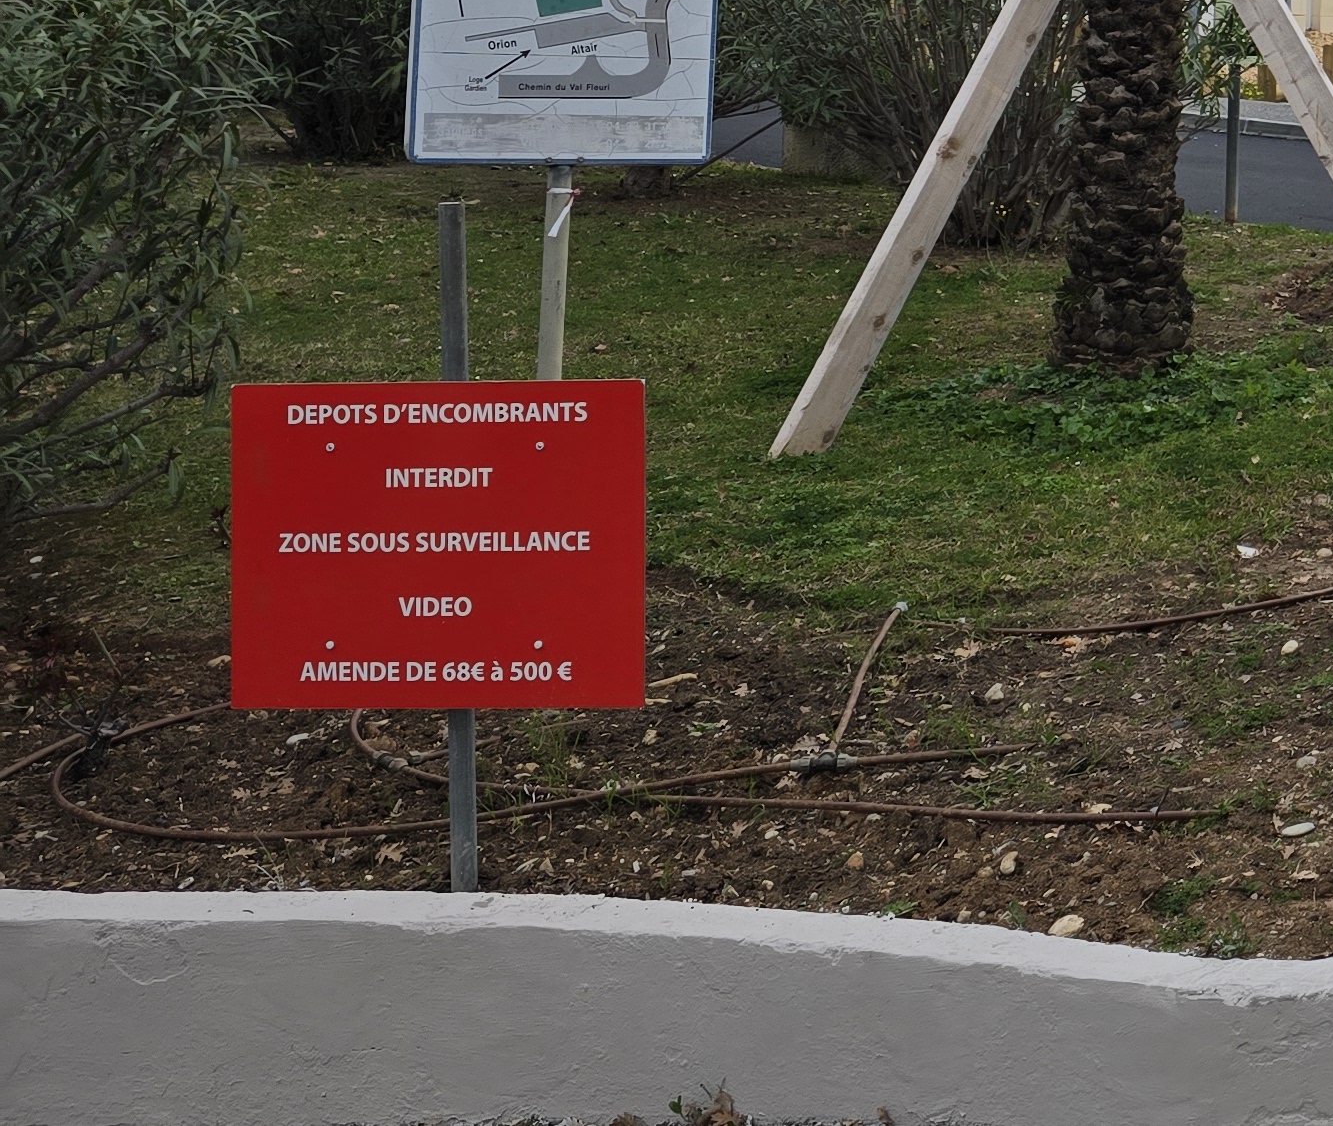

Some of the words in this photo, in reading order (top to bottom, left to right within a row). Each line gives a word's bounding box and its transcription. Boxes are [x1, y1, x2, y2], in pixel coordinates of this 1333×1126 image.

[487, 39, 518, 51] Orion
[570, 43, 598, 55] Altair
[464, 83, 488, 92] Gardien
[468, 76, 484, 84] Loge
[518, 82, 552, 91] Chemin
[555, 82, 567, 91] du
[571, 82, 583, 91] Val
[586, 82, 611, 91] Fleuri
[287, 403, 378, 425] DEPOTS
[385, 467, 494, 488] INTERDIT
[278, 532, 342, 553] ZONE
[347, 532, 410, 553] SOUS
[415, 530, 591, 553] SURVEILLANCE
[398, 596, 473, 617] VIDEO
[299, 661, 401, 682] AMENDE
[406, 661, 437, 682] DE
[441, 661, 485, 682] 68€
[490, 660, 504, 682] à
[509, 661, 553, 682] 500
[556, 661, 573, 682] €
